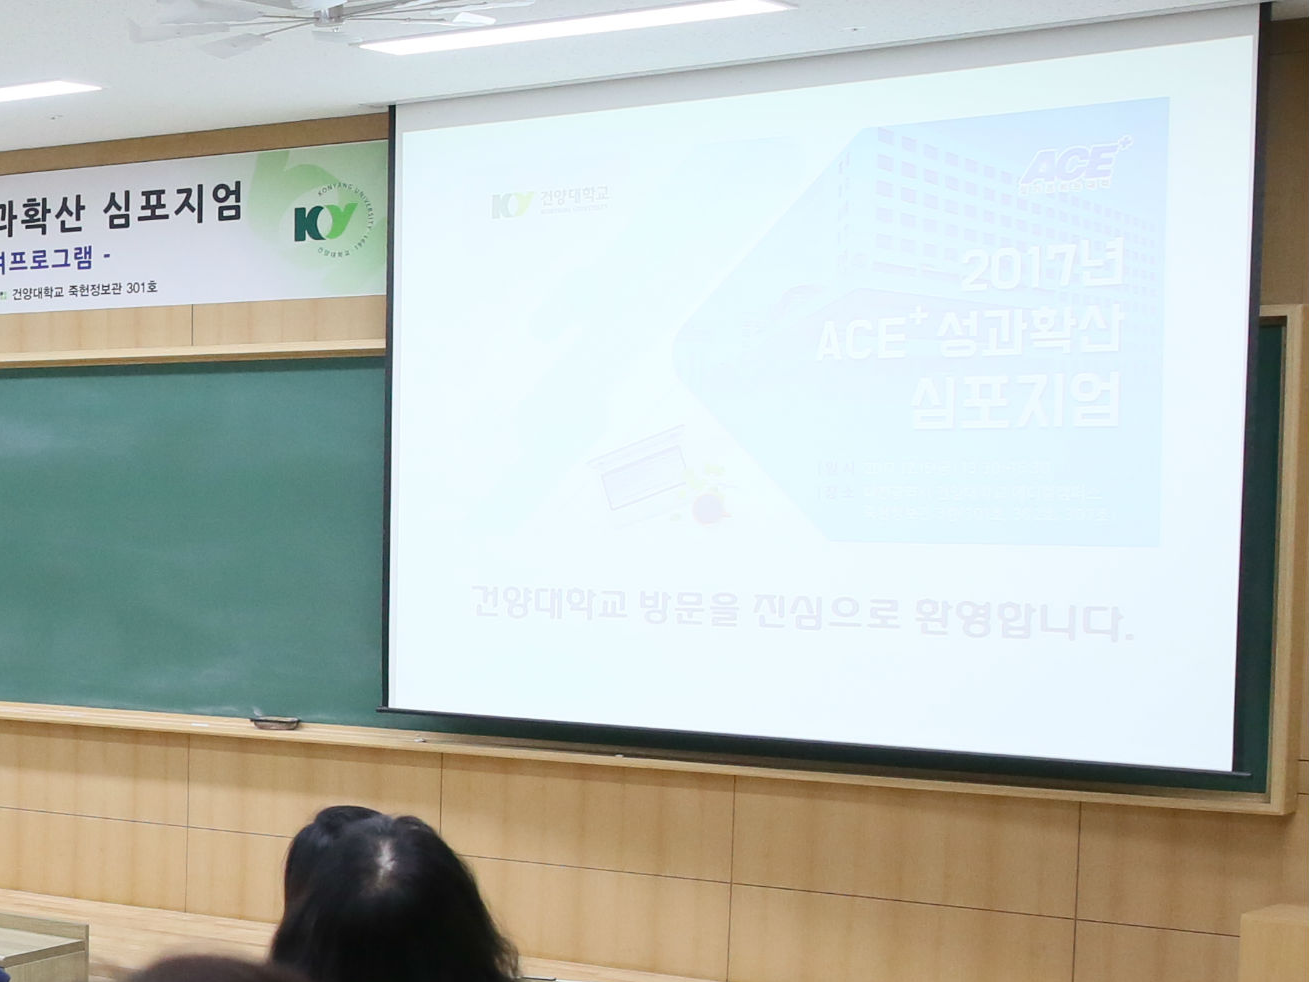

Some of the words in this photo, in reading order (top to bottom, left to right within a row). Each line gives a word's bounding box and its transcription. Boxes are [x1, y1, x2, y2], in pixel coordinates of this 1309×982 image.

[102, 180, 243, 231] 심포지엄
[540, 184, 610, 207] 건양대학교
[12, 285, 65, 301] 건양대학교
[68, 282, 123, 299] 죽헌정보관
[126, 280, 158, 295] 301호
[961, 237, 1126, 291] 2017년
[937, 301, 1127, 359] 성과확산
[910, 371, 1122, 431] 심포지엄
[470, 586, 628, 621] 건양대학교
[638, 590, 740, 627] 방문을
[752, 594, 902, 632] 진심으로
[915, 597, 1135, 643] 환영합니다.
